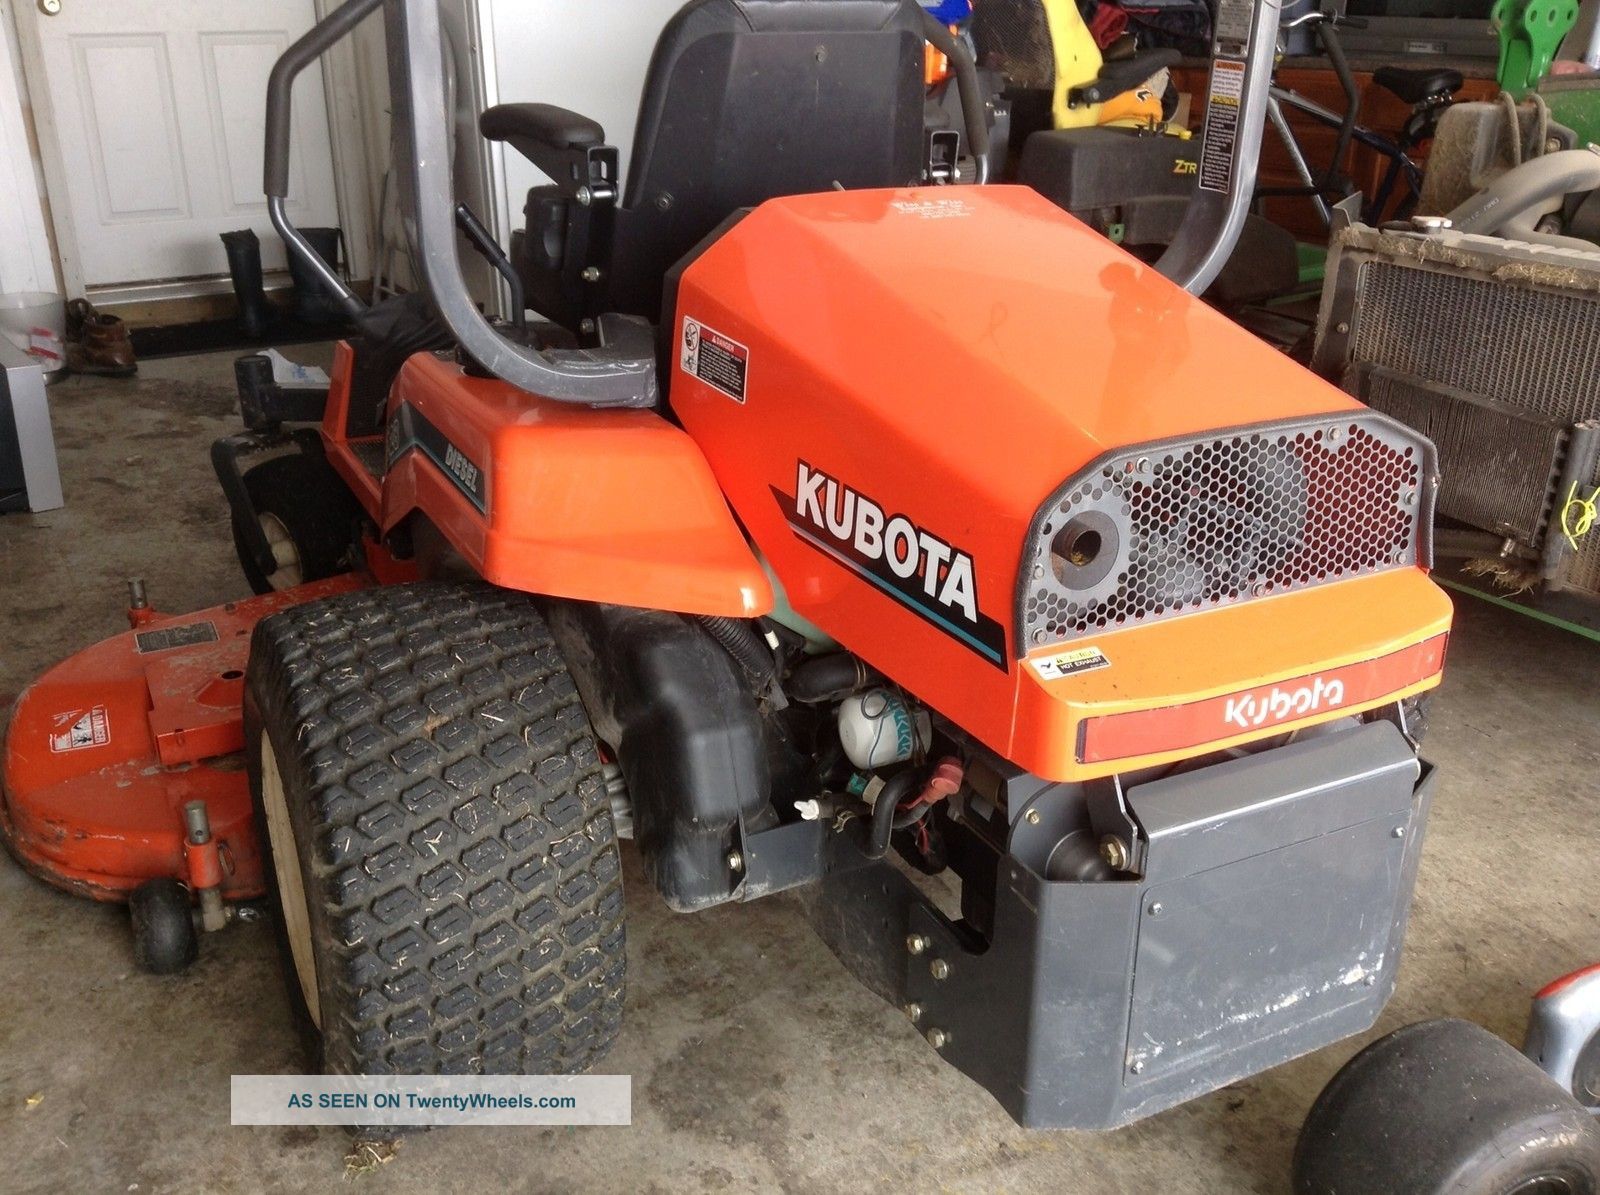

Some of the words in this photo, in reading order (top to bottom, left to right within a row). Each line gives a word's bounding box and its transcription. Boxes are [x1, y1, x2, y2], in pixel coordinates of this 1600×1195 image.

[1173, 159, 1198, 174] ZTR
[445, 443, 478, 493] DIESEL
[796, 463, 977, 623] KUBOTA
[1060, 661, 1075, 670] HOT
[1075, 657, 1102, 667] EXHAUST
[1224, 677, 1344, 728] Kubota
